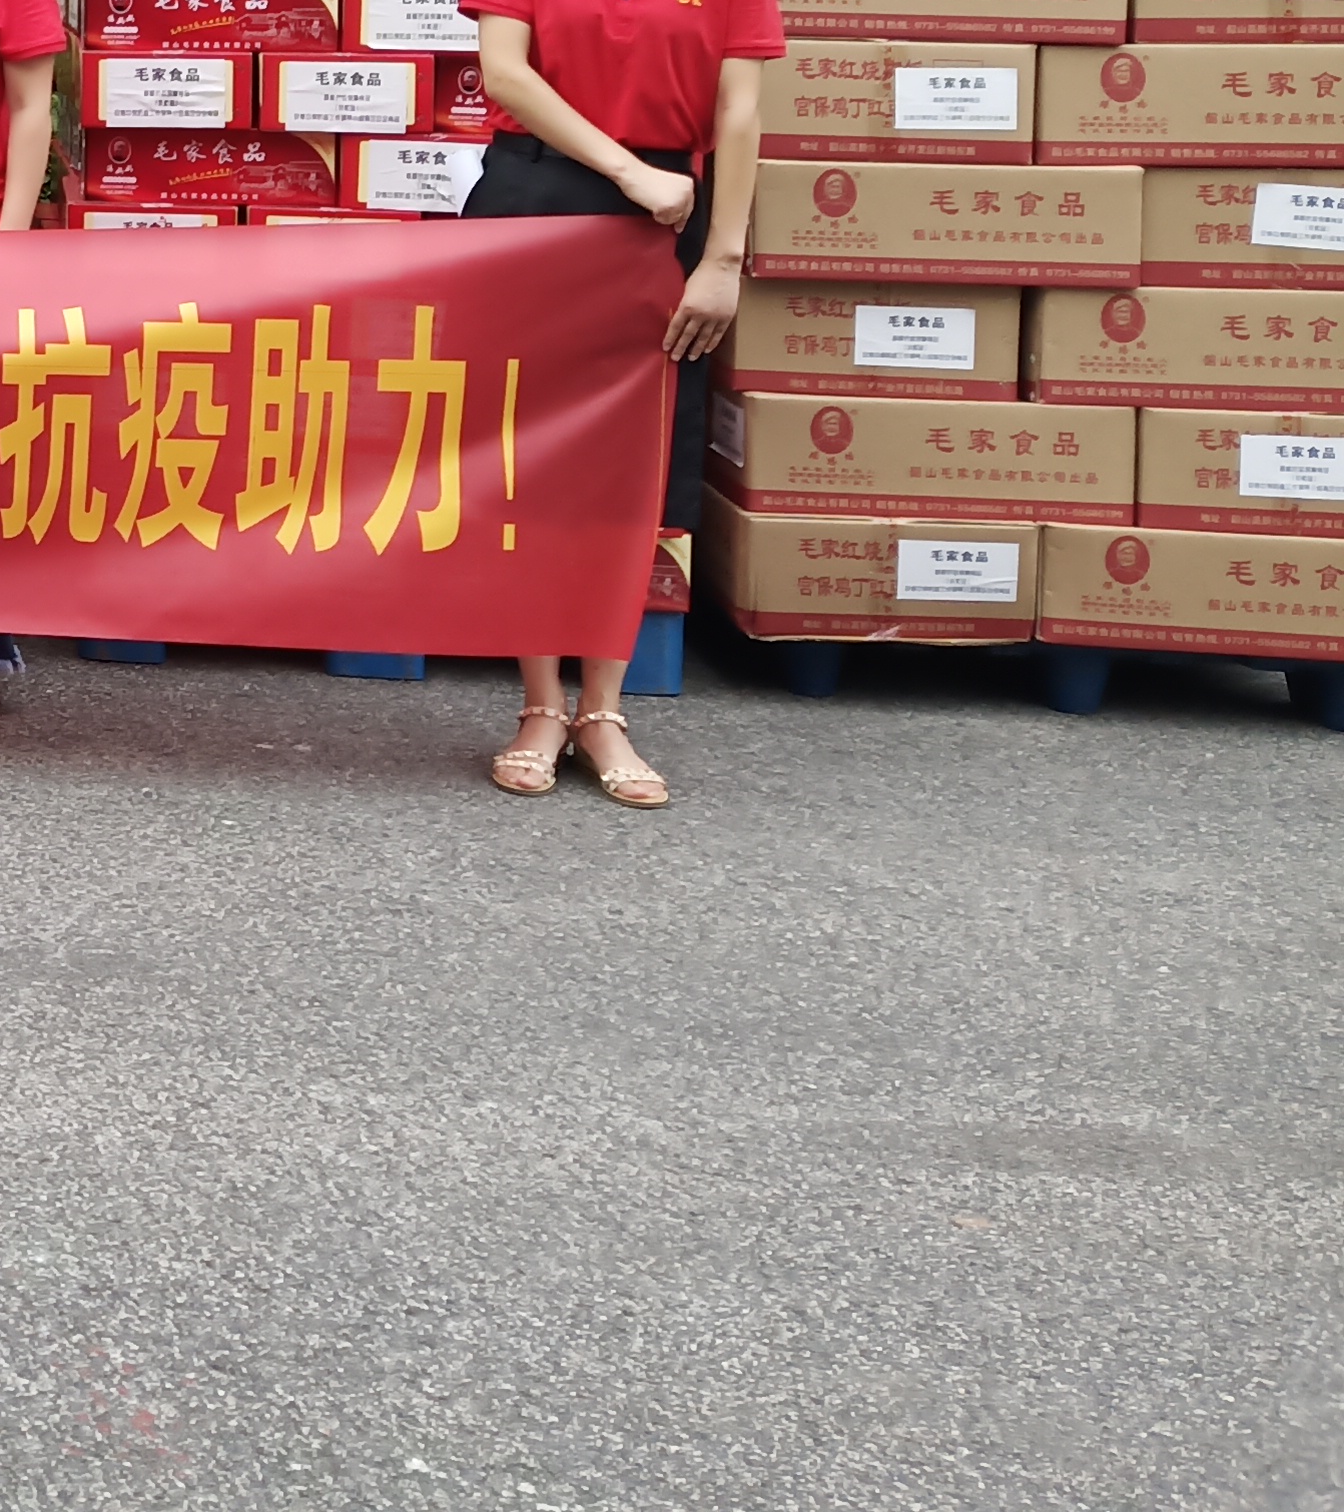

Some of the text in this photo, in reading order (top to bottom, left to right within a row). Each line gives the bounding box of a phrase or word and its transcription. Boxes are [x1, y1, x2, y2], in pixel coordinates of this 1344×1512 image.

[135, 67, 200, 83] 毛家食品
[315, 72, 381, 87] 毛家食品
[929, 77, 986, 89] 毛家食品
[1222, 71, 1342, 97] 毛家食
[153, 139, 267, 164] 毛家食品
[929, 189, 1086, 217] 毛家食品
[888, 316, 945, 329] 毛家食品
[1220, 314, 1338, 343] 毛家食
[925, 427, 1080, 457] 毛家食品
[1275, 445, 1335, 459] 毛家食品
[1195, 467, 1240, 489] 宫保
[931, 550, 988, 563] 毛家食品
[1226, 560, 1344, 591] 毛家食
